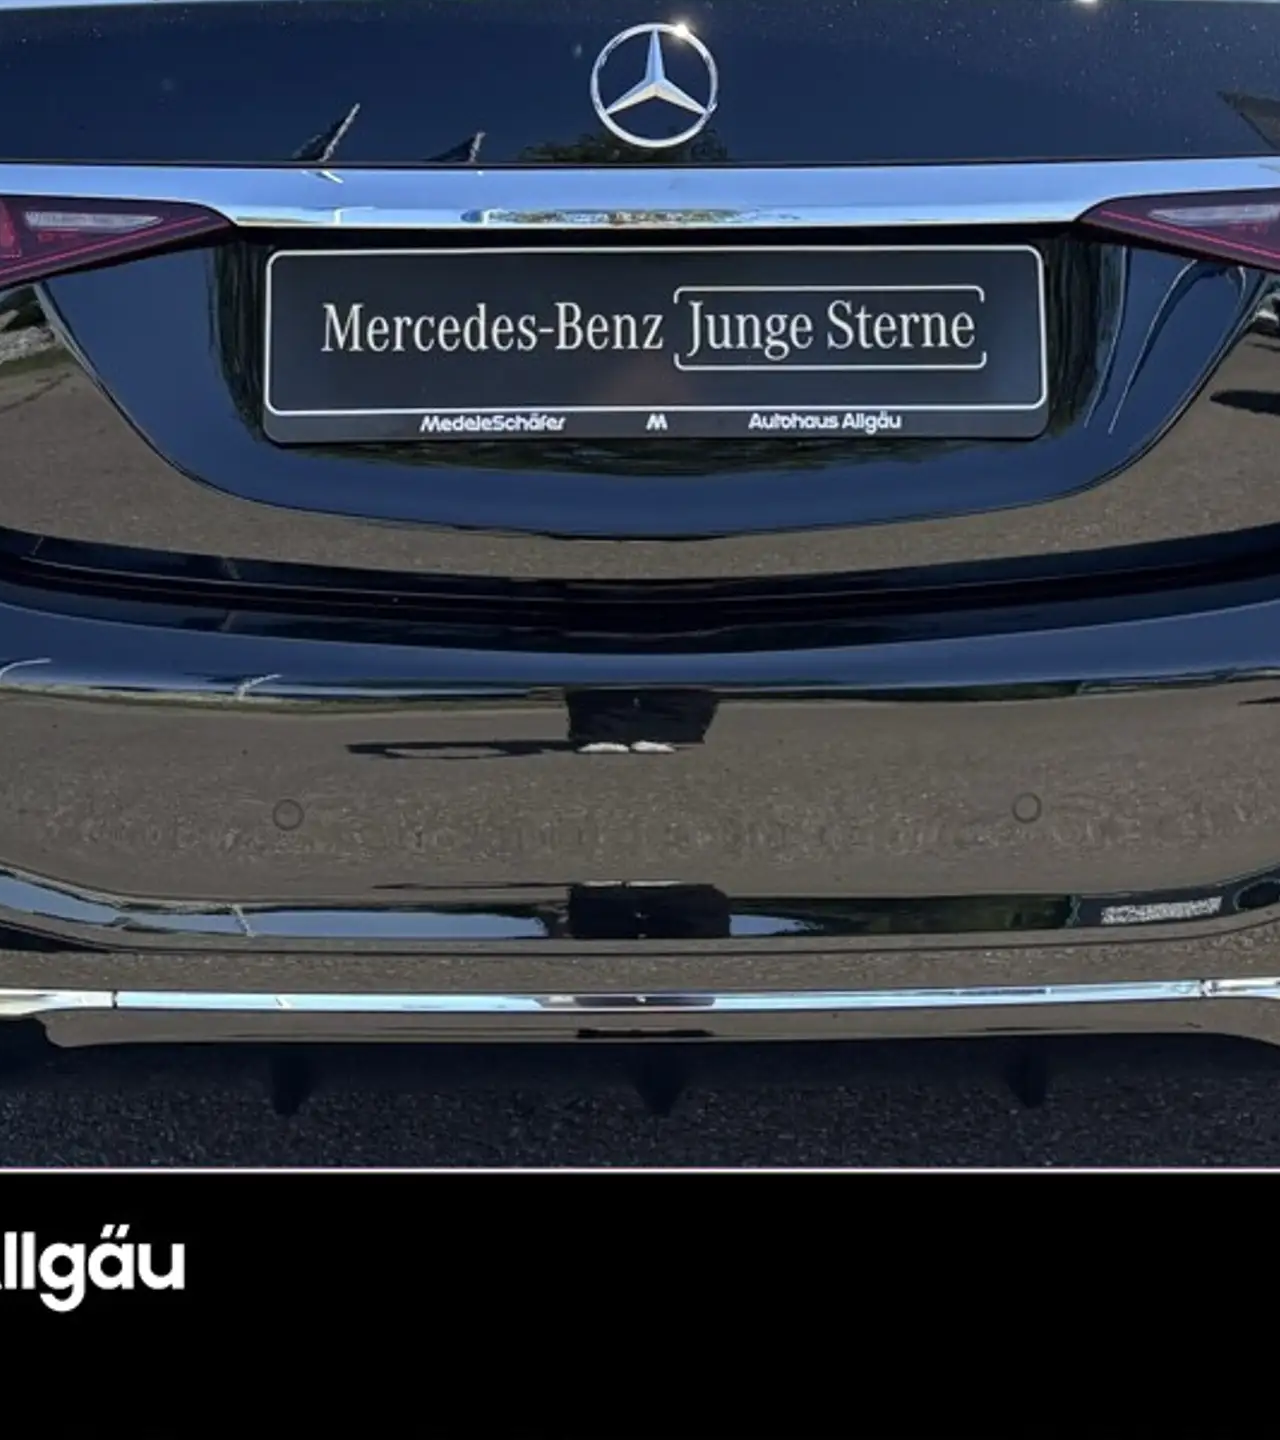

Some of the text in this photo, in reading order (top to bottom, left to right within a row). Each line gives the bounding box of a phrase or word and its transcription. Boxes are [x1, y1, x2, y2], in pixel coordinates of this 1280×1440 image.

[321, 300, 975, 360] Mercedes-Benz Junge Sterne
[419, 413, 568, 432] MedeleSchäfer
[748, 411, 838, 430] Autohaus
[843, 412, 902, 436] Allgäu
